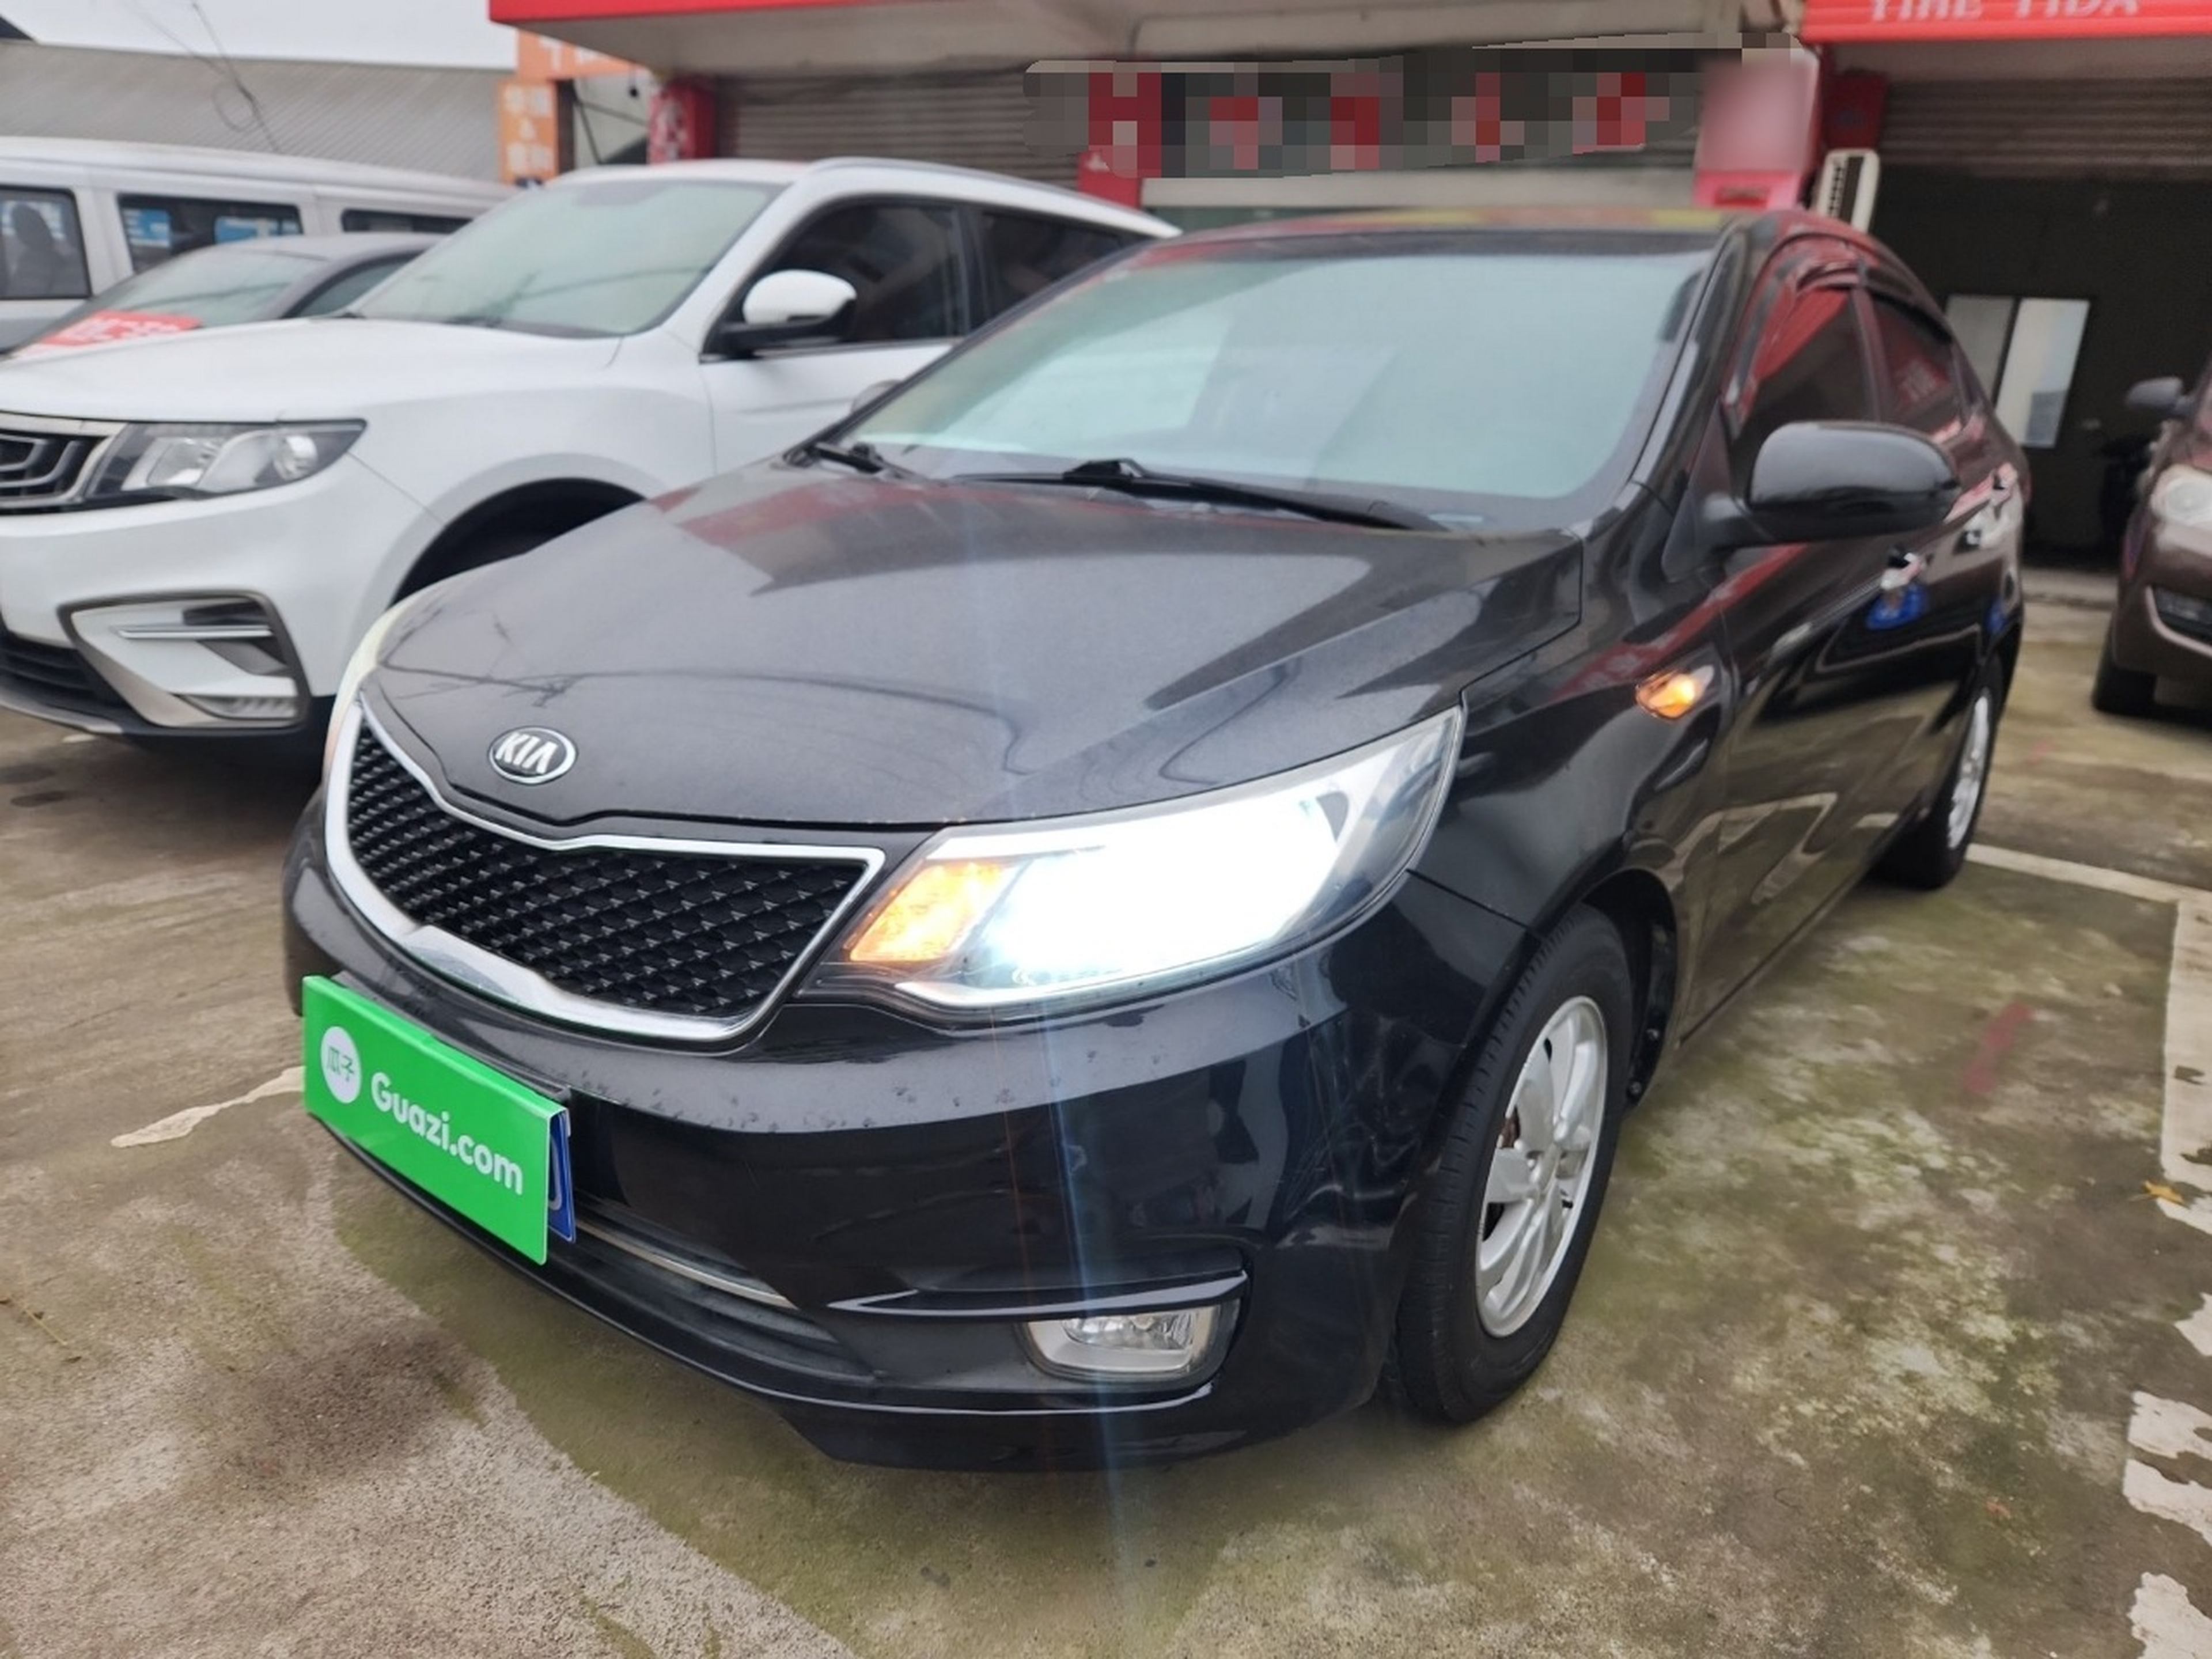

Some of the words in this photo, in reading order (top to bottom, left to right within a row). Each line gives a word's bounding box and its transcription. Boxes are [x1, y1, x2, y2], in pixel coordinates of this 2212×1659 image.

[495, 732, 558, 774] KIA
[327, 1046, 354, 1082] 瓜子
[371, 1072, 523, 1195] Guazi.com
